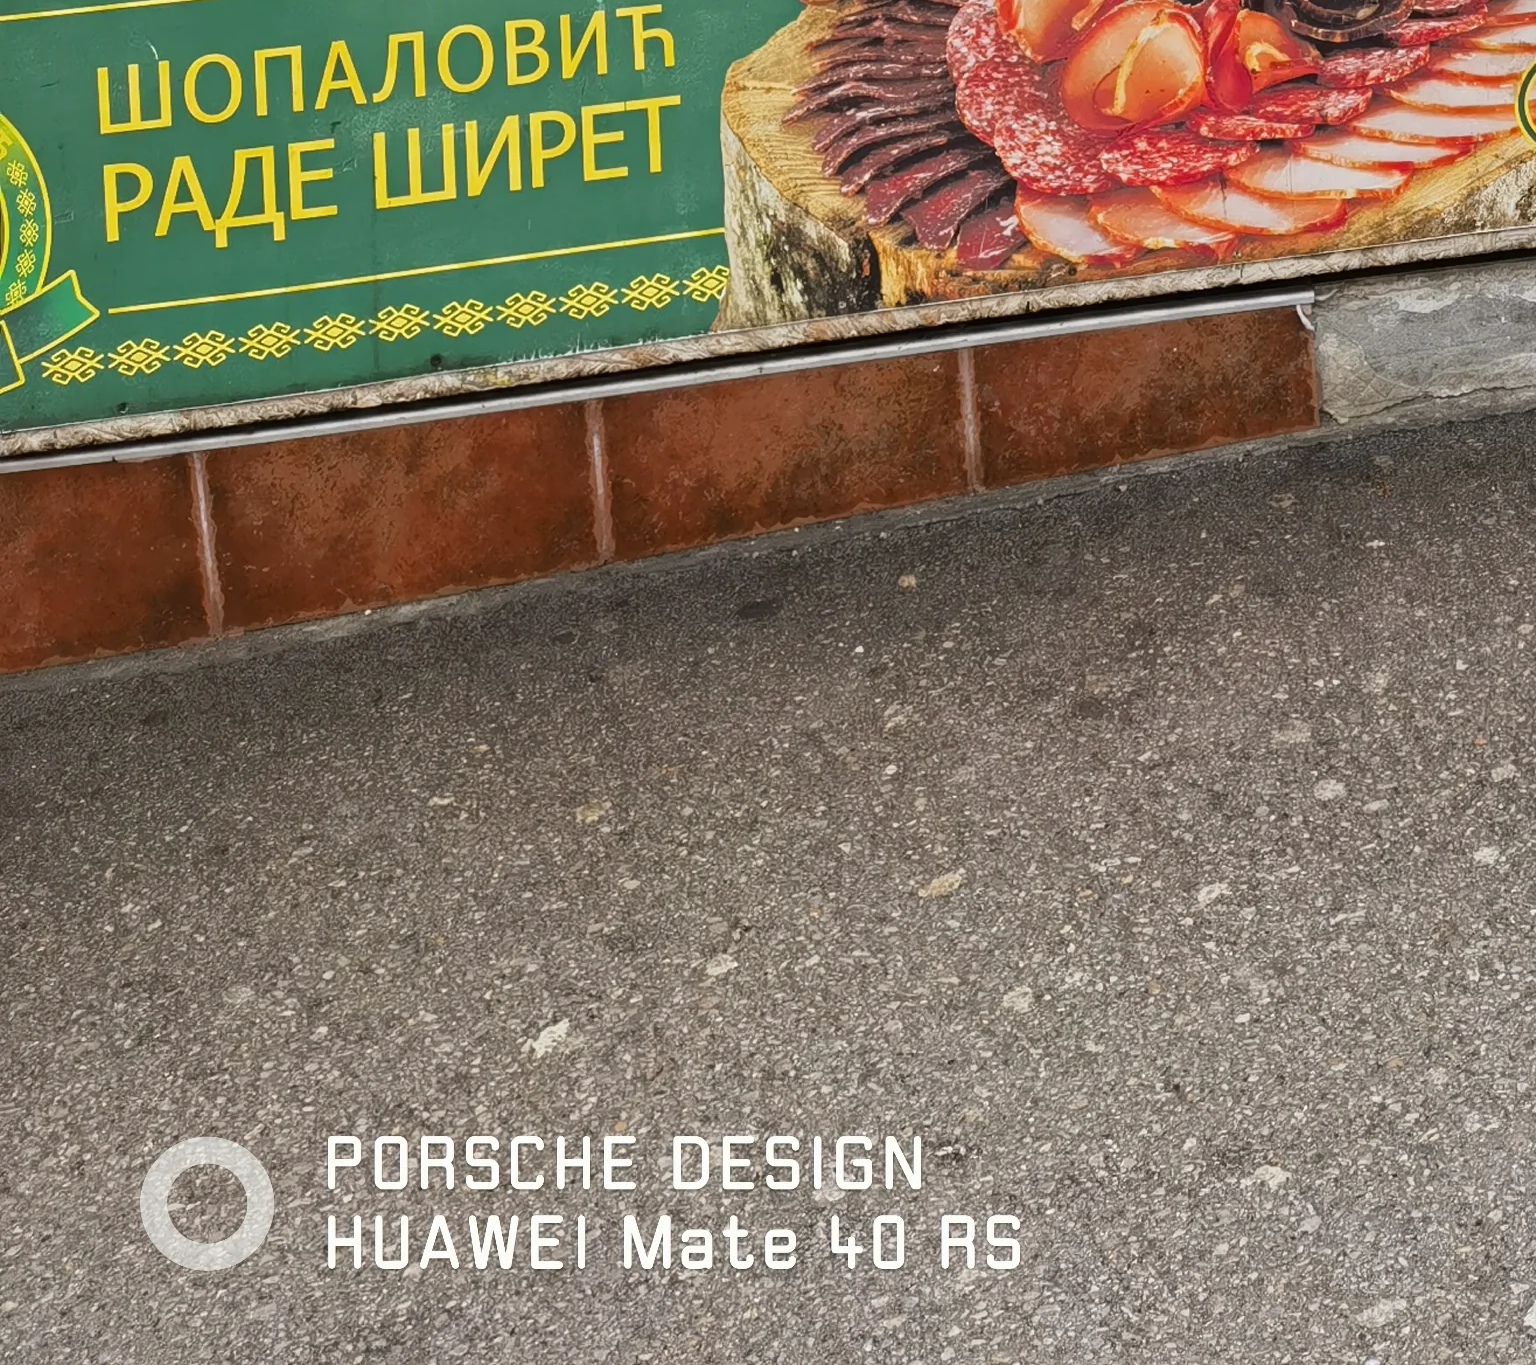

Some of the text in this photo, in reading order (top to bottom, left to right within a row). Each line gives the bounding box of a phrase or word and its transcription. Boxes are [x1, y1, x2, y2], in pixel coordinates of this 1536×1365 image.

[96, 3, 676, 136] ШОПАЛОВИЋ
[103, 94, 682, 248] РАДЕ ШИРЕТ
